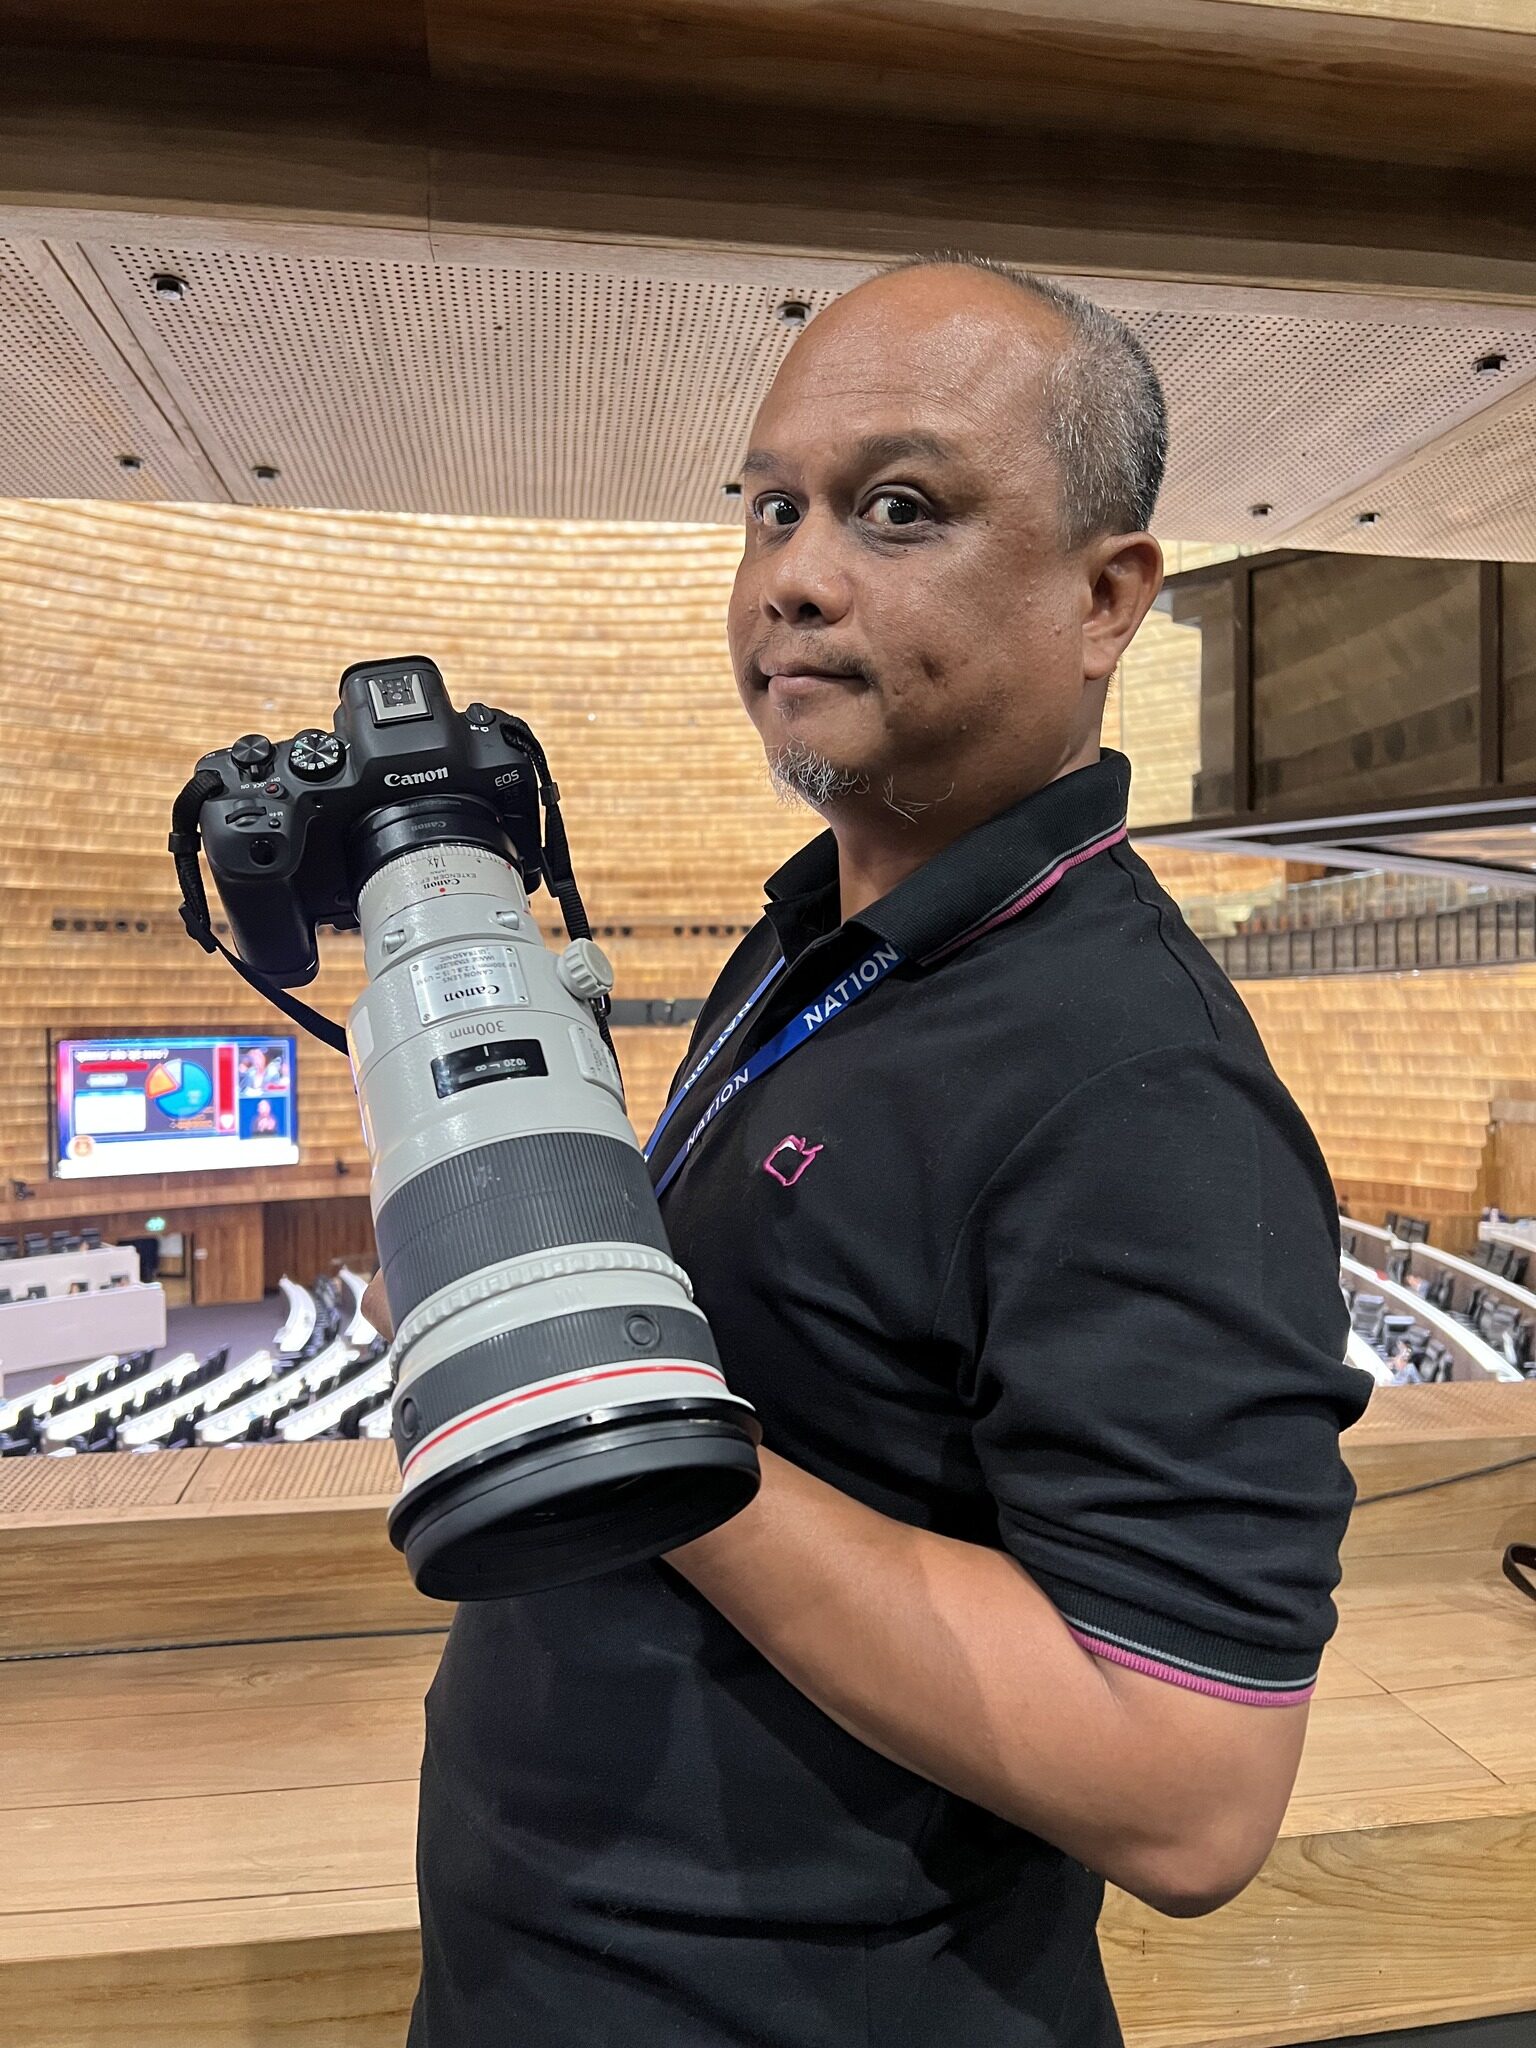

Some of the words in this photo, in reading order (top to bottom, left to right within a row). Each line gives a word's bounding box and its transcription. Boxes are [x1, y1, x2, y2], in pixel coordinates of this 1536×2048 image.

[384, 766, 449, 787] Canon
[494, 769, 520, 787] EOS
[411, 820, 447, 831] Canon
[423, 878, 460, 889] Canon
[434, 872, 477, 880] EXTENDER
[464, 969, 494, 978] CANON
[444, 984, 500, 1002] Canon
[803, 943, 900, 1031] NATION
[449, 1020, 506, 1039] 300mm
[684, 1001, 753, 1090] NATION
[686, 1068, 750, 1152] NATION
